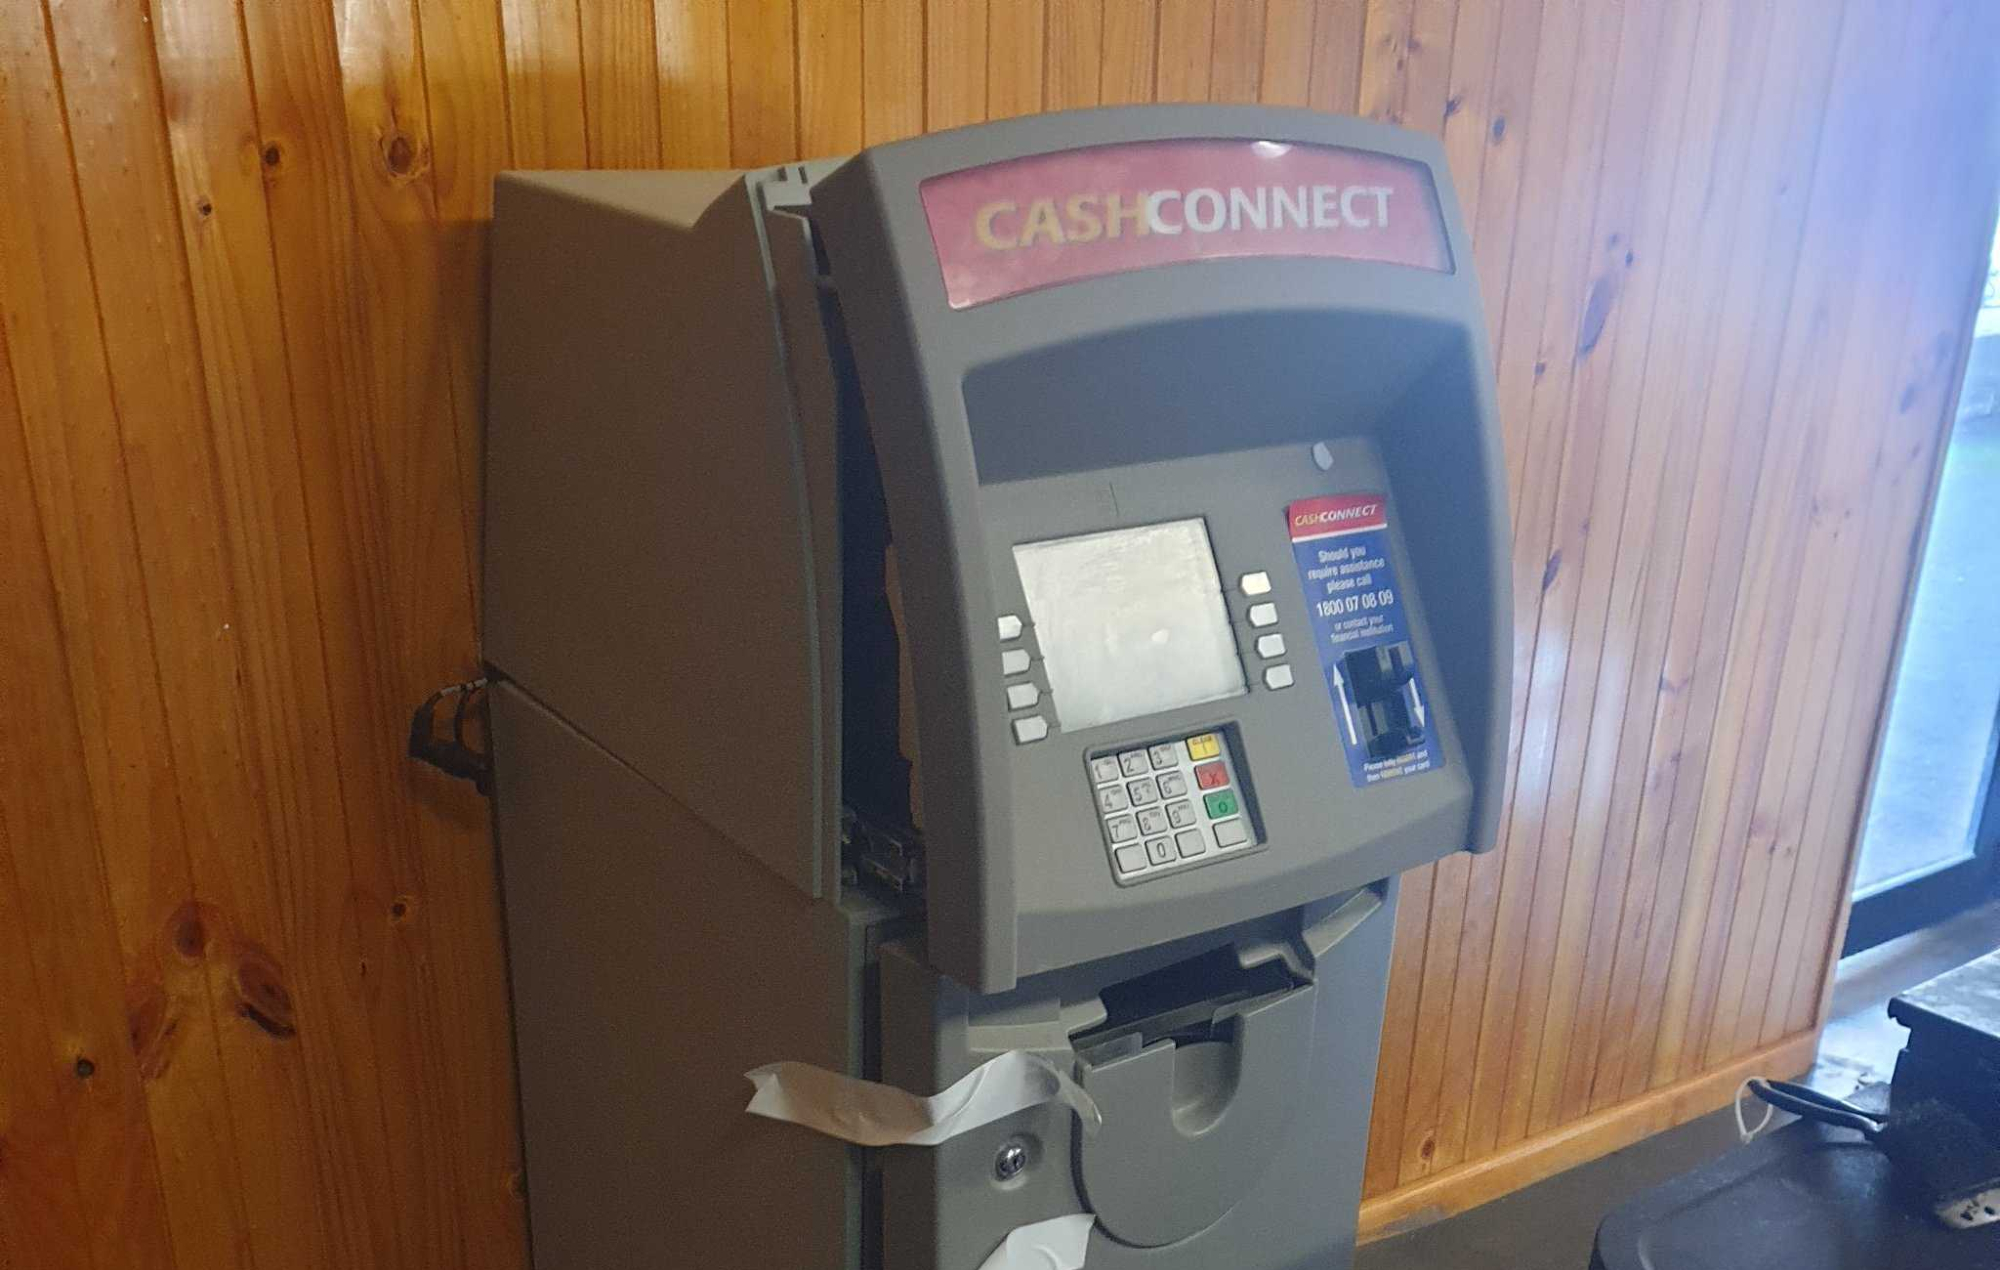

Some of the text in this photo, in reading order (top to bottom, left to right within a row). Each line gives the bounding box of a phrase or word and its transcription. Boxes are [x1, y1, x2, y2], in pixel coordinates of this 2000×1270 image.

[975, 185, 1394, 251] CASHCONNECT
[1295, 504, 1378, 527] CASHCONNECT
[1318, 546, 1366, 563] Should you
[1308, 558, 1385, 580] require assistance
[1327, 573, 1372, 595] please call
[1316, 588, 1394, 617] 1800 07 08 09
[1124, 757, 1135, 773] 2
[1154, 750, 1164, 766] 3
[1133, 787, 1143, 802] 5
[1162, 781, 1172, 795] 6
[1104, 793, 1113, 808] 4
[1142, 817, 1152, 831] 8
[1172, 810, 1182, 824] 9
[1111, 824, 1120, 838] 7
